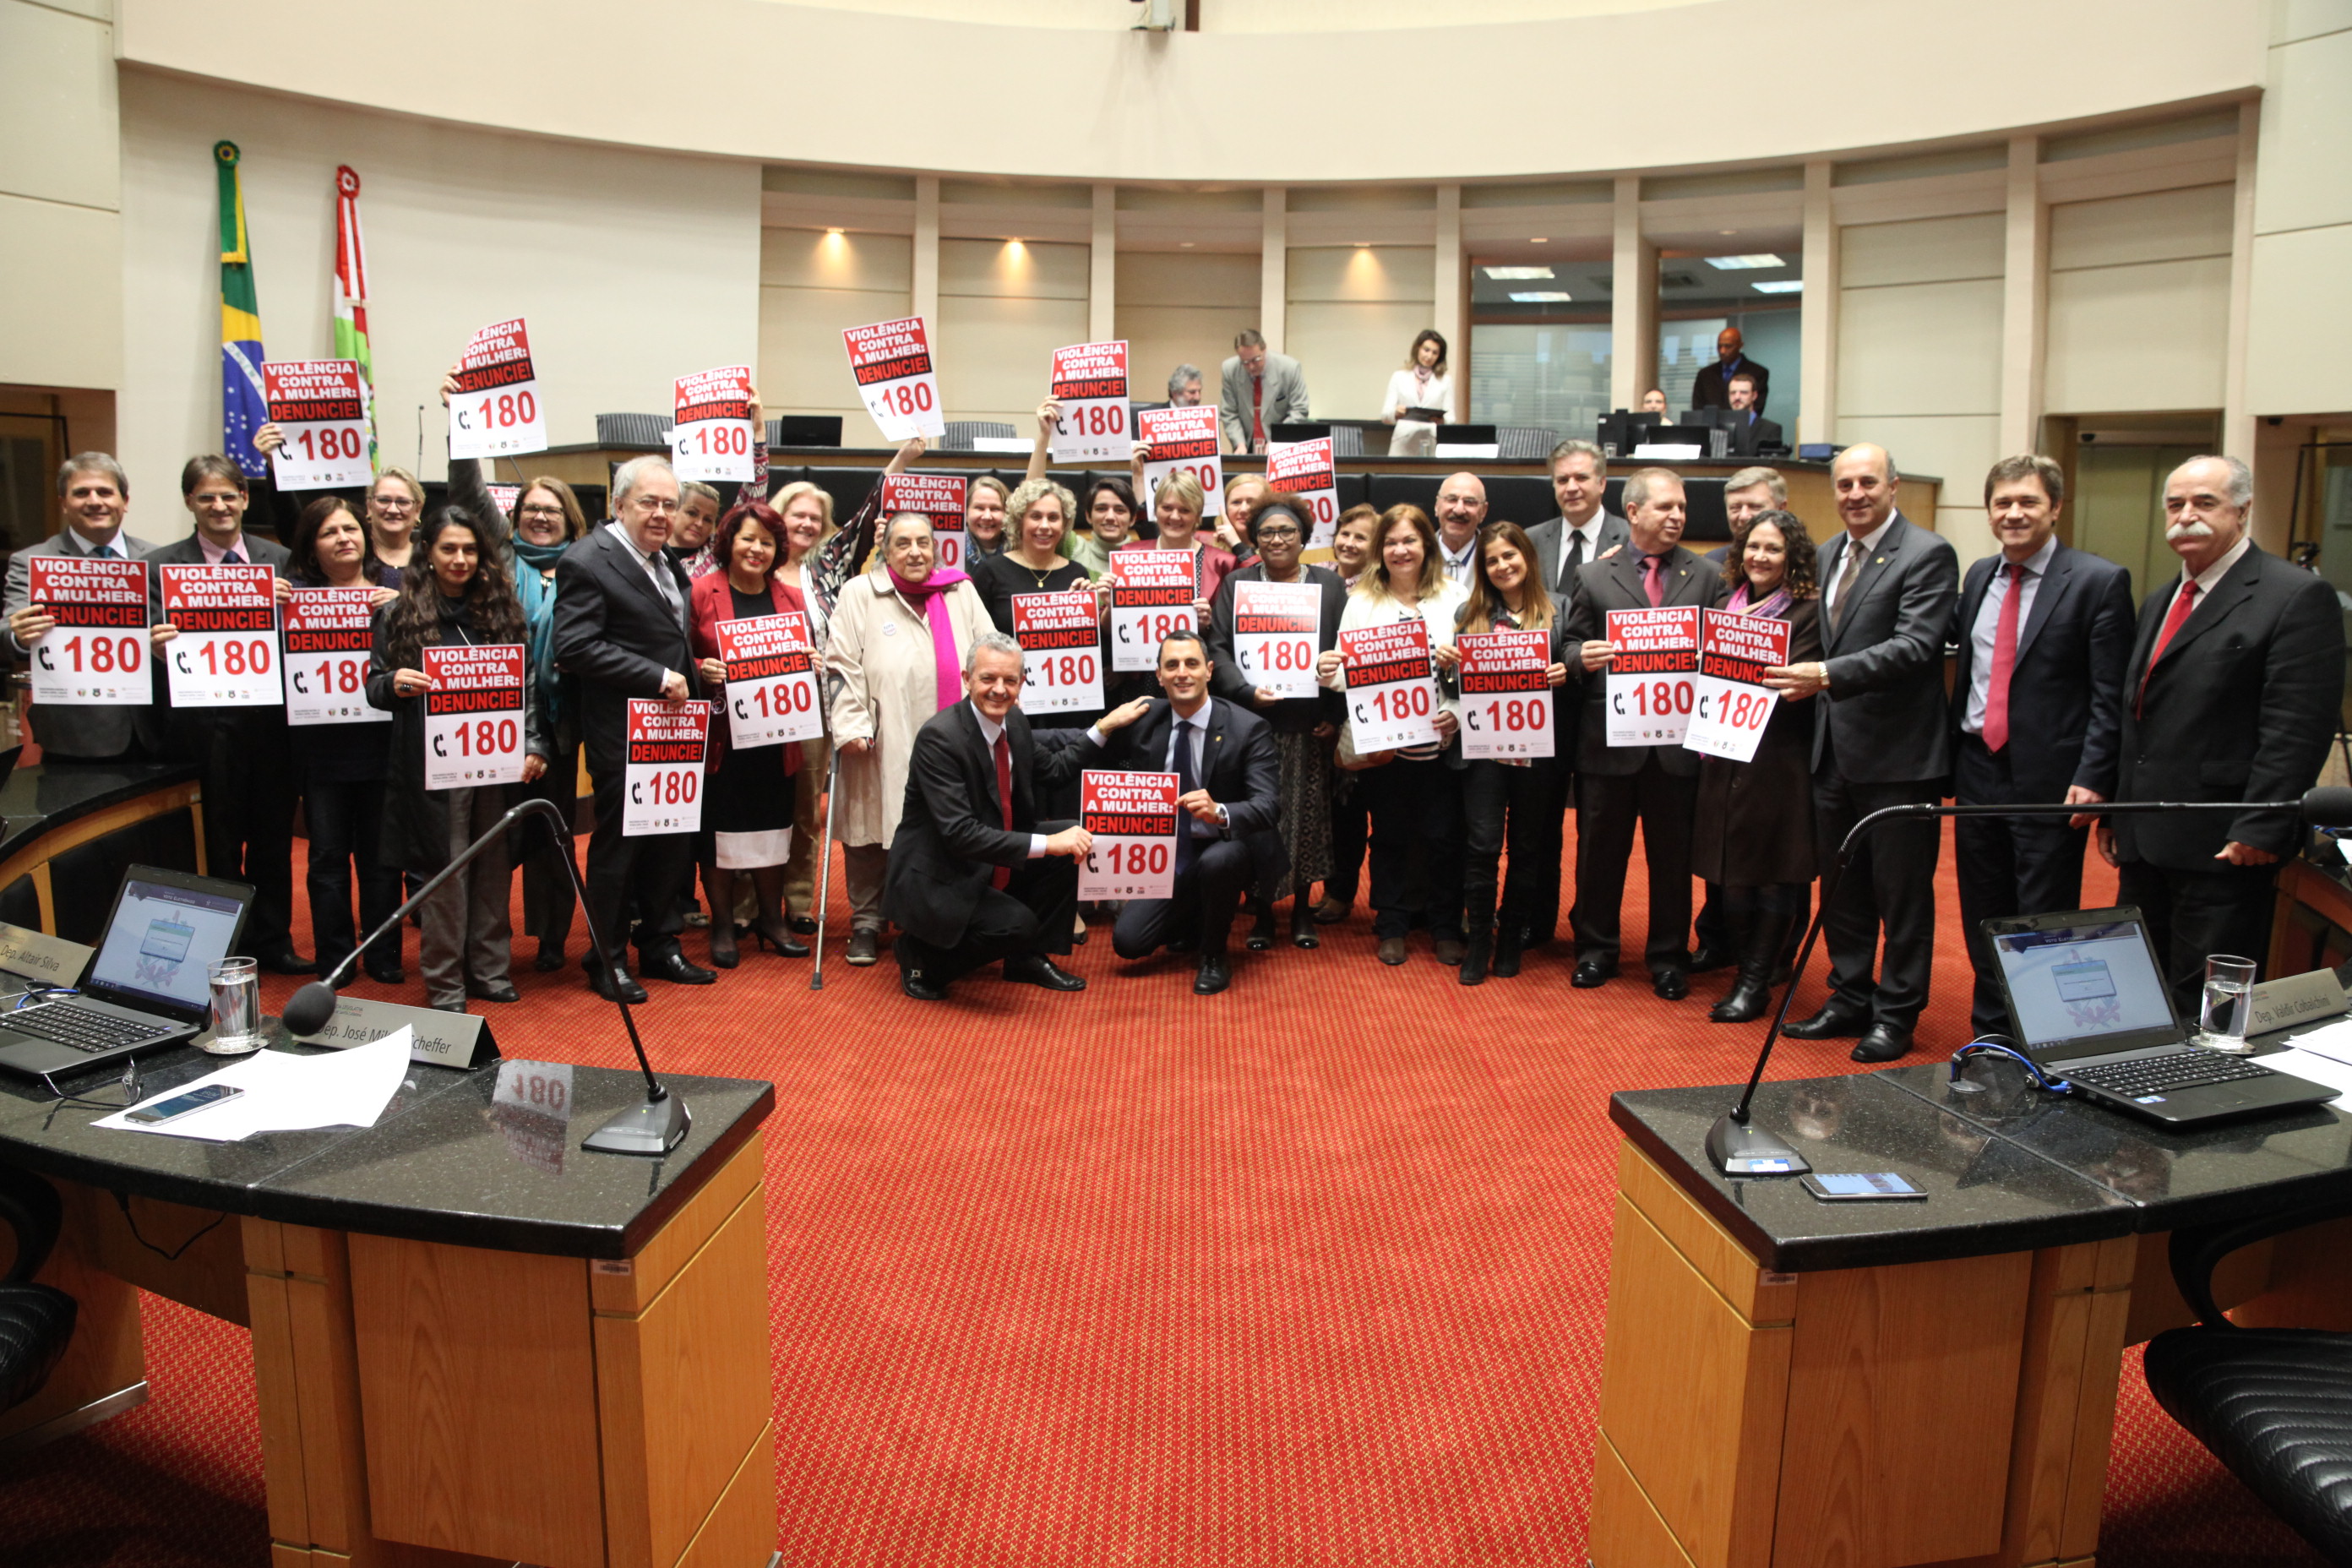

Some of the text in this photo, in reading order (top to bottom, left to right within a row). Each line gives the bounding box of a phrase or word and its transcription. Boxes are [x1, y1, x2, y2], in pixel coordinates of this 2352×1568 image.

[469, 320, 523, 346] OLÊNCIA
[847, 319, 920, 342] VIOLÊNCIA
[464, 335, 516, 358] CONTRA
[858, 334, 914, 352] CONTRA
[466, 347, 527, 370] MULHER:
[854, 343, 925, 366] A MULHER:
[1057, 344, 1123, 362] VIOLÊNCIA
[267, 361, 353, 375] VIOLÊNCIA
[857, 356, 929, 384] DENUNCIE!
[1062, 357, 1114, 369] CONTRA
[279, 376, 345, 387] CONTRA
[678, 368, 747, 389] VIOLÊNCIA
[1054, 367, 1124, 382] A MULHER:
[270, 387, 357, 400] A MULHER:
[685, 379, 738, 396] CONTRA
[1054, 381, 1124, 398] DENUNCIE!
[678, 389, 749, 408] A MULHER:
[882, 382, 933, 416] 180
[271, 401, 359, 420] DENUNCIE!
[479, 390, 536, 429] 180
[677, 402, 749, 424] DENUNCIE!
[1143, 408, 1213, 423] VIOLÊNCIA
[1073, 406, 1124, 436] 180
[1152, 420, 1206, 433] CONTRA
[298, 428, 360, 460] 180
[696, 427, 747, 455] 180
[1144, 429, 1215, 443] A MULHER:
[1271, 438, 1329, 463] VIOLÊNCIA
[1276, 452, 1321, 469] CONTRA
[1269, 462, 1330, 482] A MULHER:
[888, 476, 961, 490] VIOLÊNCIA
[896, 488, 953, 500] CONTRA
[885, 499, 961, 512] A MULHER:
[35, 559, 141, 576] VIOLÊNCIA
[1114, 553, 1190, 564] VIOLÊNCIA
[166, 566, 268, 580] VIOLÊNCIA
[1124, 564, 1182, 575] CONTRA
[46, 574, 128, 589] CONTRA
[180, 581, 258, 594] CONTRA
[1116, 575, 1192, 586] A MULHER:
[1239, 583, 1315, 596] VIOLÊNCIA
[34, 589, 143, 602] A MULHER:
[169, 595, 270, 607] A MULHER:
[1017, 592, 1092, 607] VIOLÊNCIA
[1116, 589, 1193, 606] DENUNCIE!
[1248, 594, 1306, 605] CONTRA
[38, 607, 143, 625] ENUNCIE!
[298, 604, 369, 616] CONTRA
[1026, 606, 1085, 618] CONTRA
[1239, 604, 1315, 615] A MULHER:
[1612, 608, 1694, 625] VIOLÊNCIA
[171, 612, 271, 629] DENUNCIE!
[288, 616, 372, 629] A MULHE
[721, 615, 800, 636] VIOLÊNCIA
[1019, 618, 1095, 630] A MULHER:
[1137, 614, 1190, 644] 180
[1238, 617, 1316, 632] DENUNCIE!
[1707, 612, 1784, 636] VIOLÊNCIA
[732, 629, 793, 647] CONTRA
[1342, 622, 1423, 644] VIOLÊNCIA
[1621, 623, 1684, 638] CONTRA
[1715, 628, 1773, 649] CONTRA
[289, 632, 373, 651] DENUNCI
[1019, 630, 1096, 650] DENUNCIE!
[1354, 636, 1415, 654] CONTRA
[1462, 633, 1545, 648] VIOLÊNCIA
[1613, 636, 1694, 651] A MULHER:
[64, 636, 141, 672] 180
[200, 640, 270, 675] 180
[428, 647, 519, 662] VIOLÊNCIA
[726, 648, 737, 661] A
[1257, 640, 1311, 671] 180
[1347, 646, 1426, 667] A MULHER:
[1472, 647, 1535, 660] CONTRA
[1706, 640, 1783, 664] A MULHER:
[440, 662, 509, 676] CONTRA
[728, 654, 809, 680] DENUNCIE!
[1042, 655, 1095, 686] 180
[1463, 658, 1546, 672] A MULHER:
[1612, 652, 1696, 672] DENUNCIE!
[1704, 656, 1768, 683] DENUNC
[1348, 660, 1429, 686] DENUNCIE!
[431, 675, 520, 690] A MULHER:
[1464, 675, 1548, 692] DENUNCIE!
[430, 690, 520, 713] DENUNCIE!
[754, 681, 812, 718] 180
[1373, 686, 1430, 722] 180
[1633, 681, 1694, 716] 180
[1487, 699, 1545, 732] 180
[1718, 689, 1768, 730] 180
[642, 716, 696, 727] CONTRA
[455, 719, 517, 757] 180
[632, 728, 704, 740] A MULHER:
[632, 743, 702, 762] DENUNCIE!
[650, 770, 697, 805] 180
[1087, 774, 1174, 787] VIOLÊNCIA
[1097, 787, 1163, 800] CONTRA
[1086, 800, 1173, 813] A MULHER:
[1086, 815, 1173, 833] DENUNCIE!
[1108, 844, 1168, 874] 180
[1, 945, 59, 972] Dep. Altair Silva
[2255, 1011, 2274, 1024] Dep.
[342, 1026, 366, 1041] José
[411, 1034, 451, 1054] cheffer
